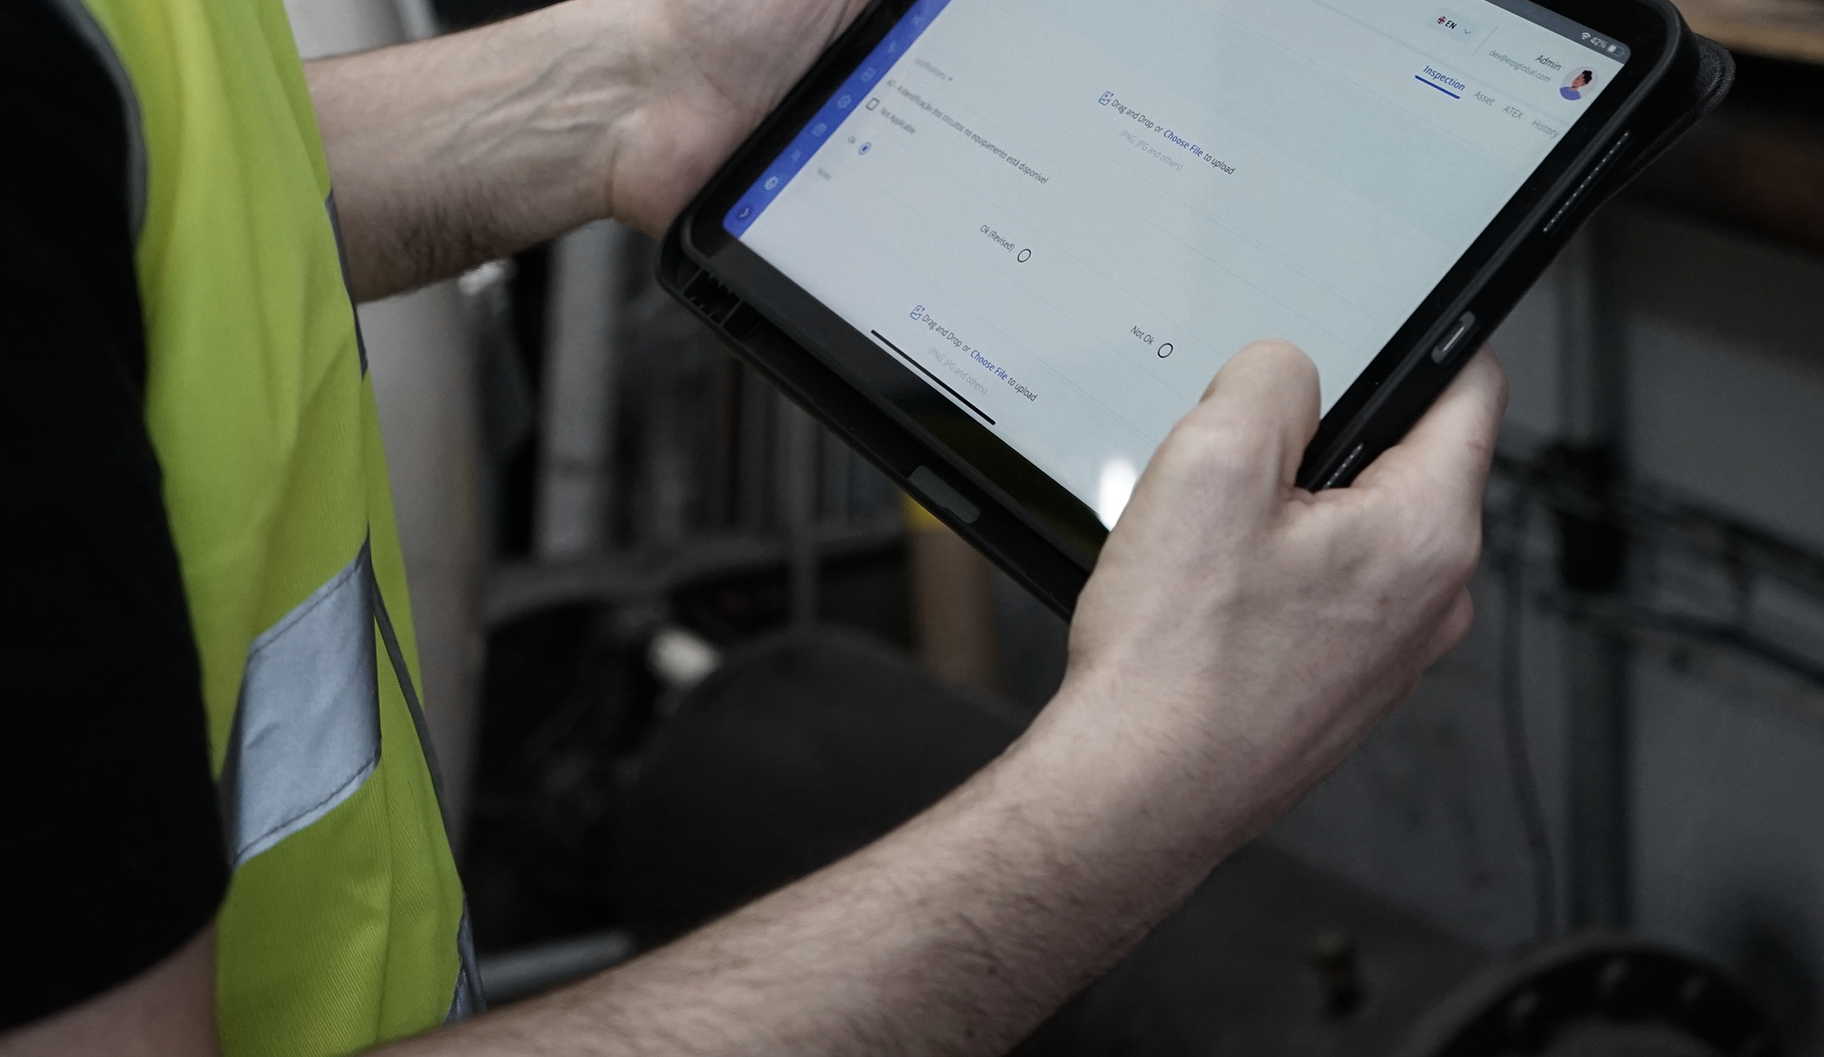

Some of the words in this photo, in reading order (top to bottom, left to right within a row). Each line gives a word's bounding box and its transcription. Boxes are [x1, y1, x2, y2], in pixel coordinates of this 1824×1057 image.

[1445, 20, 1457, 30] EN
[1590, 36, 1608, 49] 42%
[1535, 54, 1562, 71] Admin
[1423, 65, 1465, 91] Inspection
[1473, 91, 1495, 106] Asset
[1502, 105, 1524, 120] ATEX
[1111, 99, 1127, 115] Drag
[1125, 108, 1140, 120] and
[1137, 115, 1154, 129] Drop
[1154, 125, 1164, 133] or
[1163, 130, 1190, 149] Choose
[1189, 144, 1204, 157] File
[1203, 153, 1213, 163] to
[1212, 159, 1236, 175] upload
[1532, 119, 1560, 139] History
[971, 134, 1008, 158] equipamento
[1006, 155, 1021, 167] está
[1018, 163, 1049, 184] disponível
[1147, 146, 1162, 159] and
[1160, 154, 1184, 172] others)
[979, 224, 990, 234] Ok
[990, 231, 1015, 252] (Revised)
[1130, 325, 1145, 338] Not
[1143, 334, 1155, 346] Ok
[921, 314, 938, 331] Drag
[935, 325, 949, 337] and
[946, 332, 963, 348] Drop
[962, 345, 971, 353] or
[970, 350, 996, 372] Choose
[994, 367, 1008, 381] File
[1007, 377, 1016, 387] to
[1014, 383, 1039, 402] upload
[953, 367, 968, 380] and
[965, 375, 989, 396] others)
